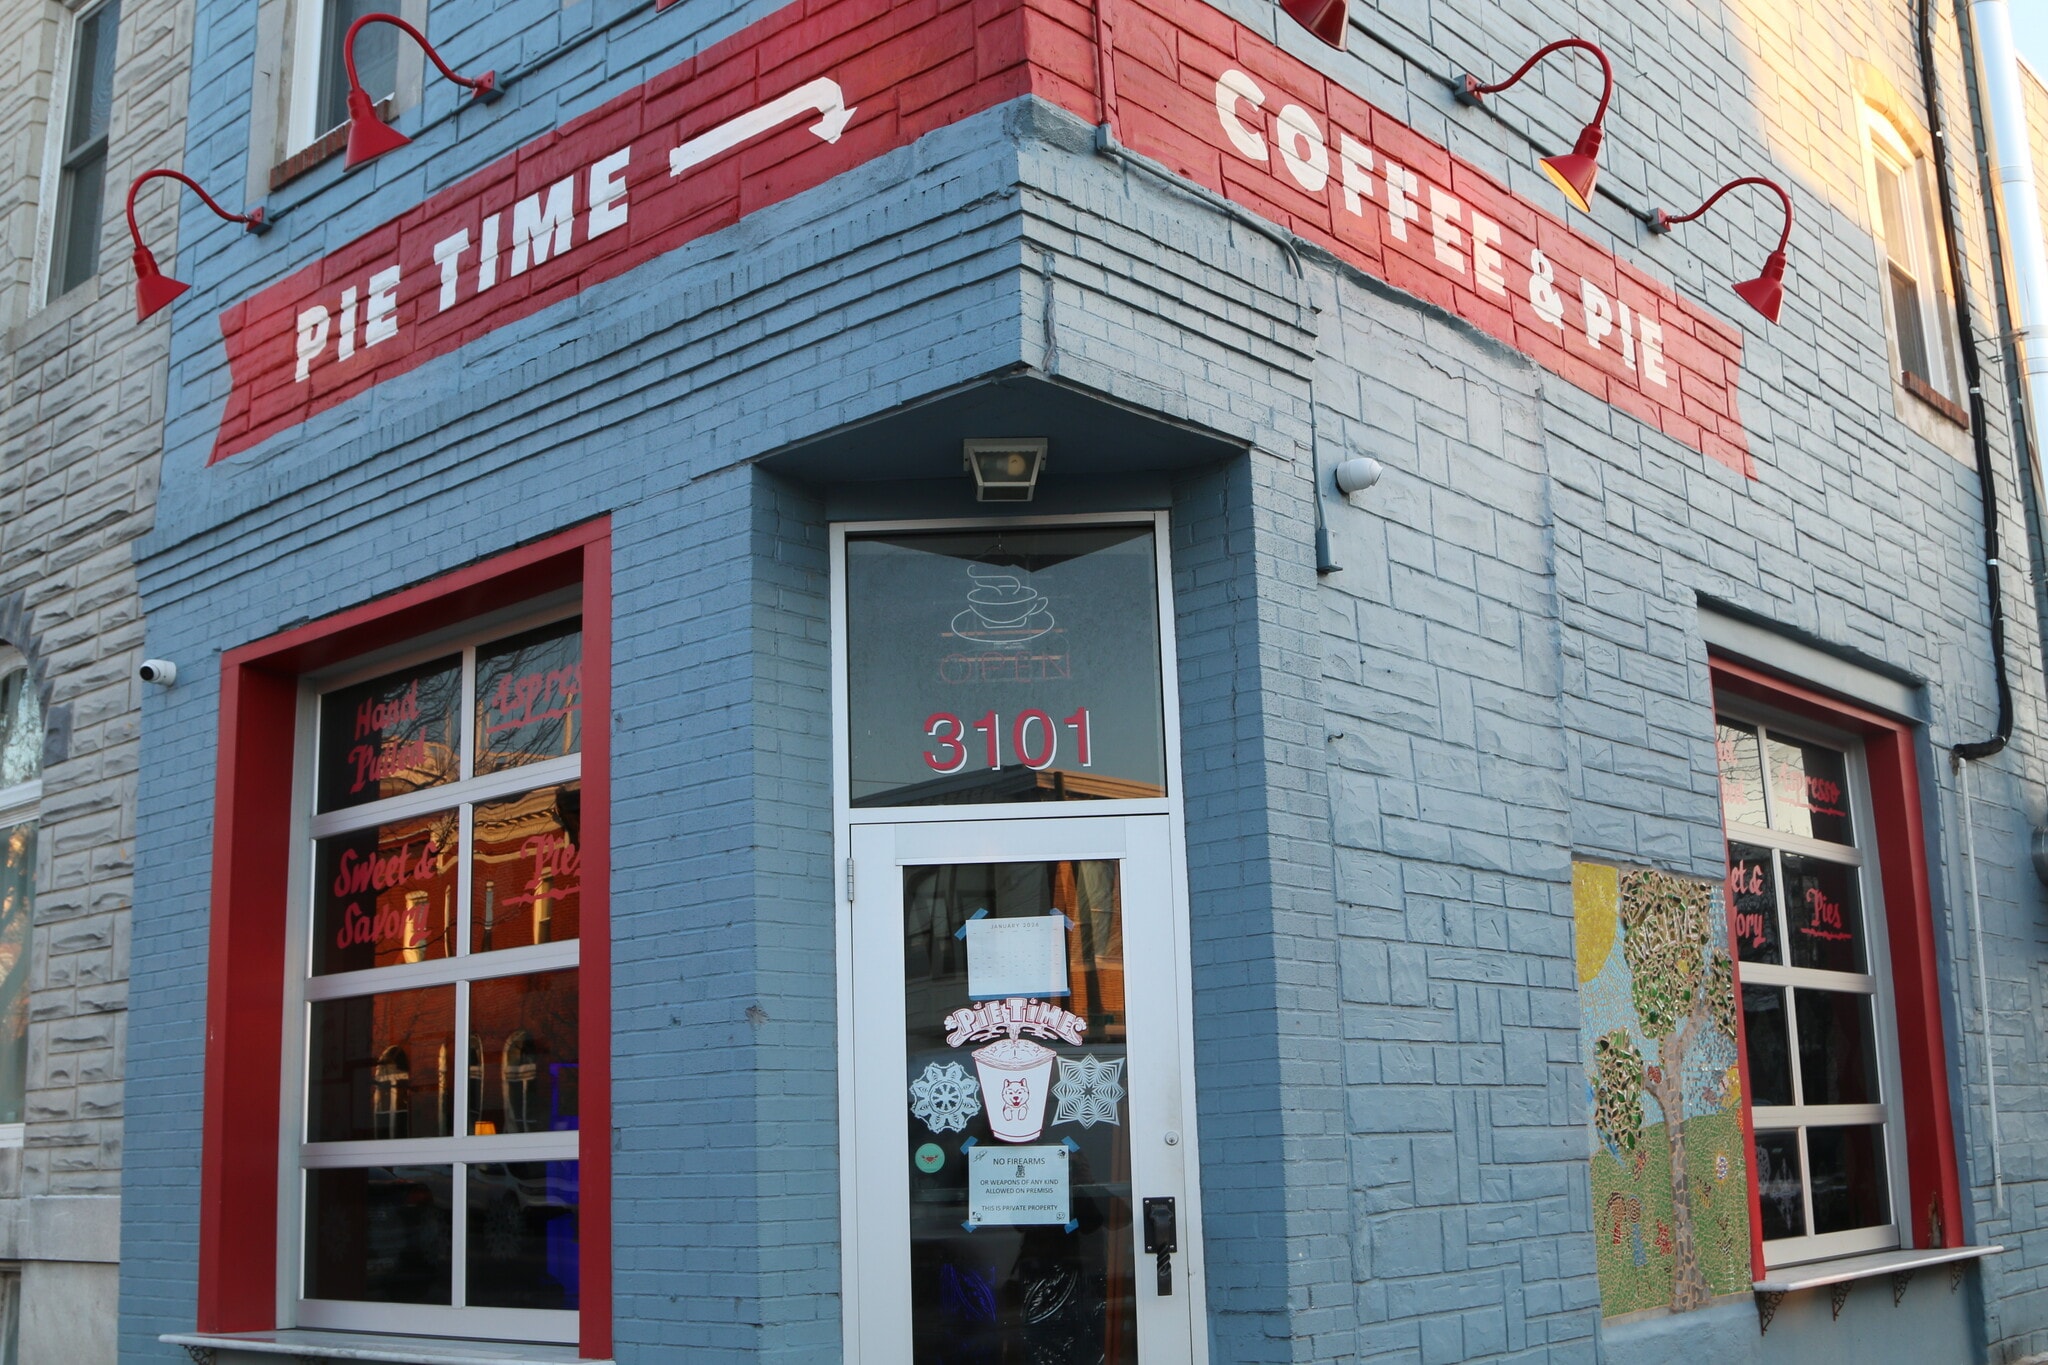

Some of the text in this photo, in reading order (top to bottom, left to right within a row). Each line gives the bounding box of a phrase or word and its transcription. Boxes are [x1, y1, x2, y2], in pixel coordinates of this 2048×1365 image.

[1215, 69, 1668, 388] COFFEE & PIE
[294, 145, 631, 383] PIE TIME
[939, 651, 1071, 685] OPEN
[354, 678, 420, 741] Hand
[348, 725, 427, 794] Pulled
[922, 706, 1092, 774] 3101
[333, 841, 438, 898] Sweet &
[1749, 864, 1764, 897] &
[336, 902, 432, 949] Savory
[1805, 887, 1842, 929] Pies
[993, 1157, 1046, 1166] NO FIREARMS
